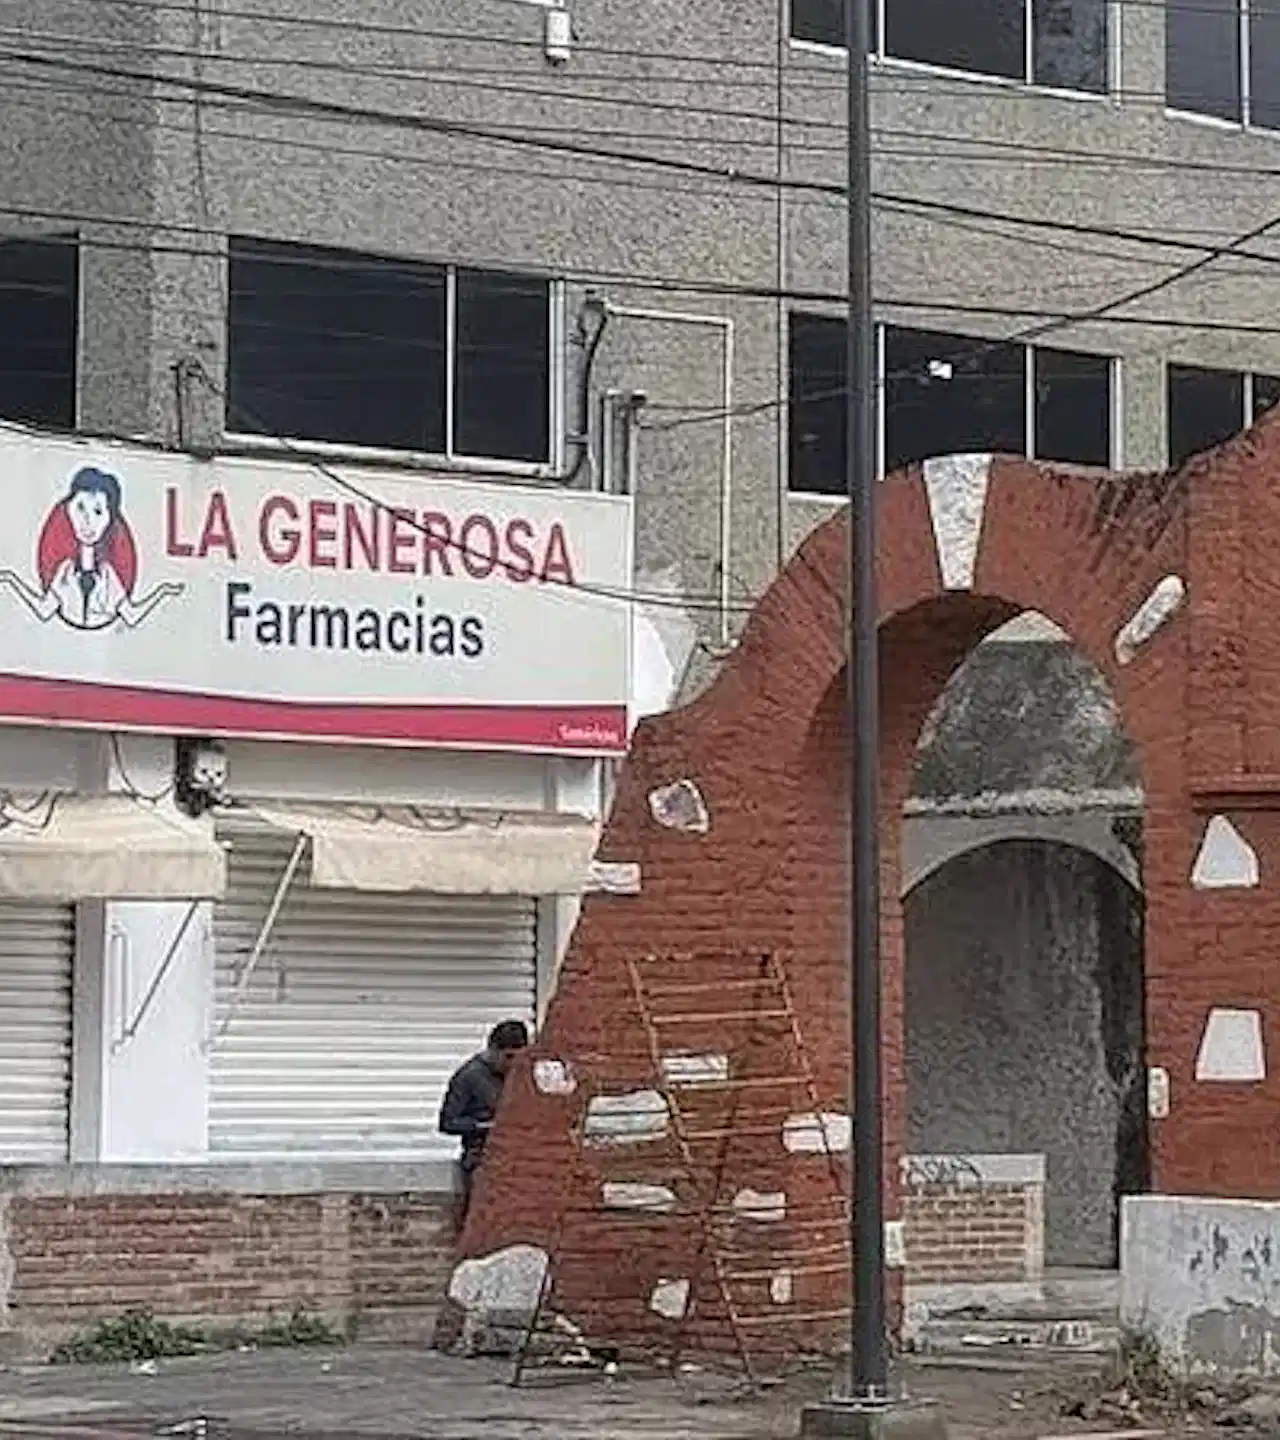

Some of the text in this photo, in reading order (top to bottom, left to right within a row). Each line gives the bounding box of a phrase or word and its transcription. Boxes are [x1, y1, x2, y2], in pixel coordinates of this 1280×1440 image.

[163, 487, 576, 586] LA GENEROSA
[226, 581, 484, 658] Farmacias
